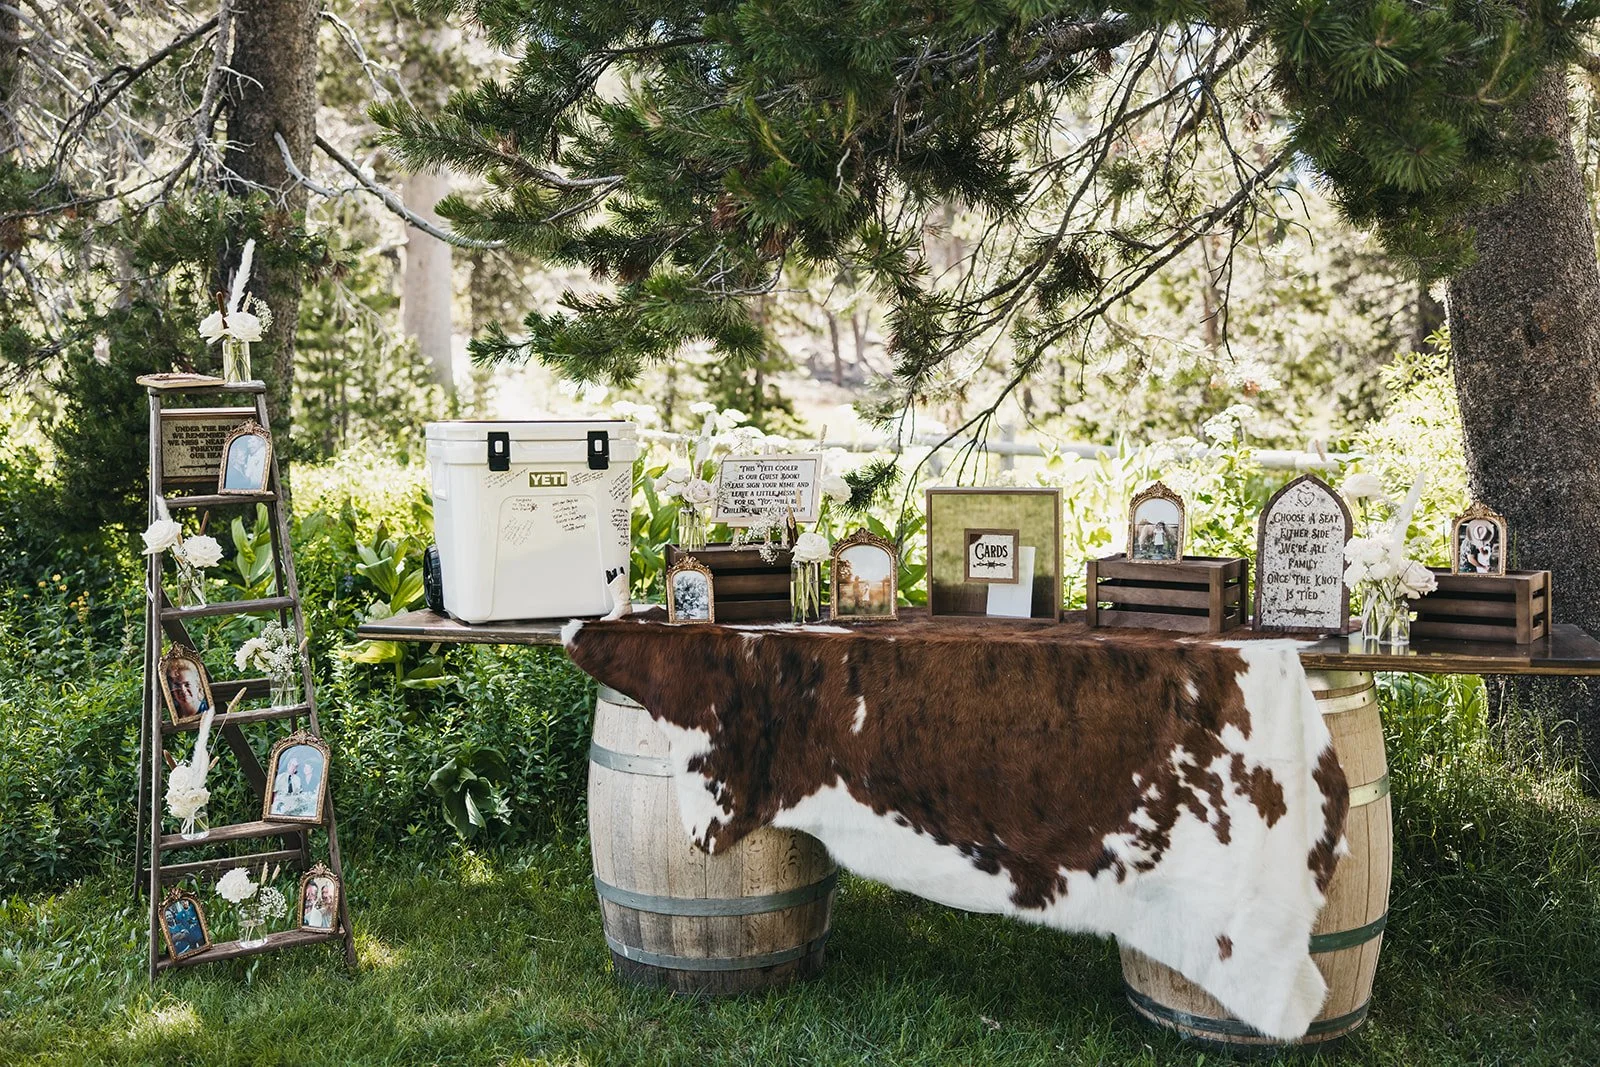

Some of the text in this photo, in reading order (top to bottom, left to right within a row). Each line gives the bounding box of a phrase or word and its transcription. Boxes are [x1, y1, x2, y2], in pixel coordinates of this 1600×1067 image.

[740, 464, 756, 472] THIS
[757, 464, 774, 472] YETI
[530, 474, 566, 486] YETI
[1274, 512, 1340, 524] CHOOSE A SEAT
[1280, 528, 1330, 541] EITHER SIDE
[974, 542, 1008, 560] CARDS
[1278, 542, 1327, 555] WE'RE ALL
[1288, 558, 1318, 571] FAMILY
[1266, 573, 1338, 586] ONCE THE KNOT
[1286, 588, 1318, 601] IS TIED
